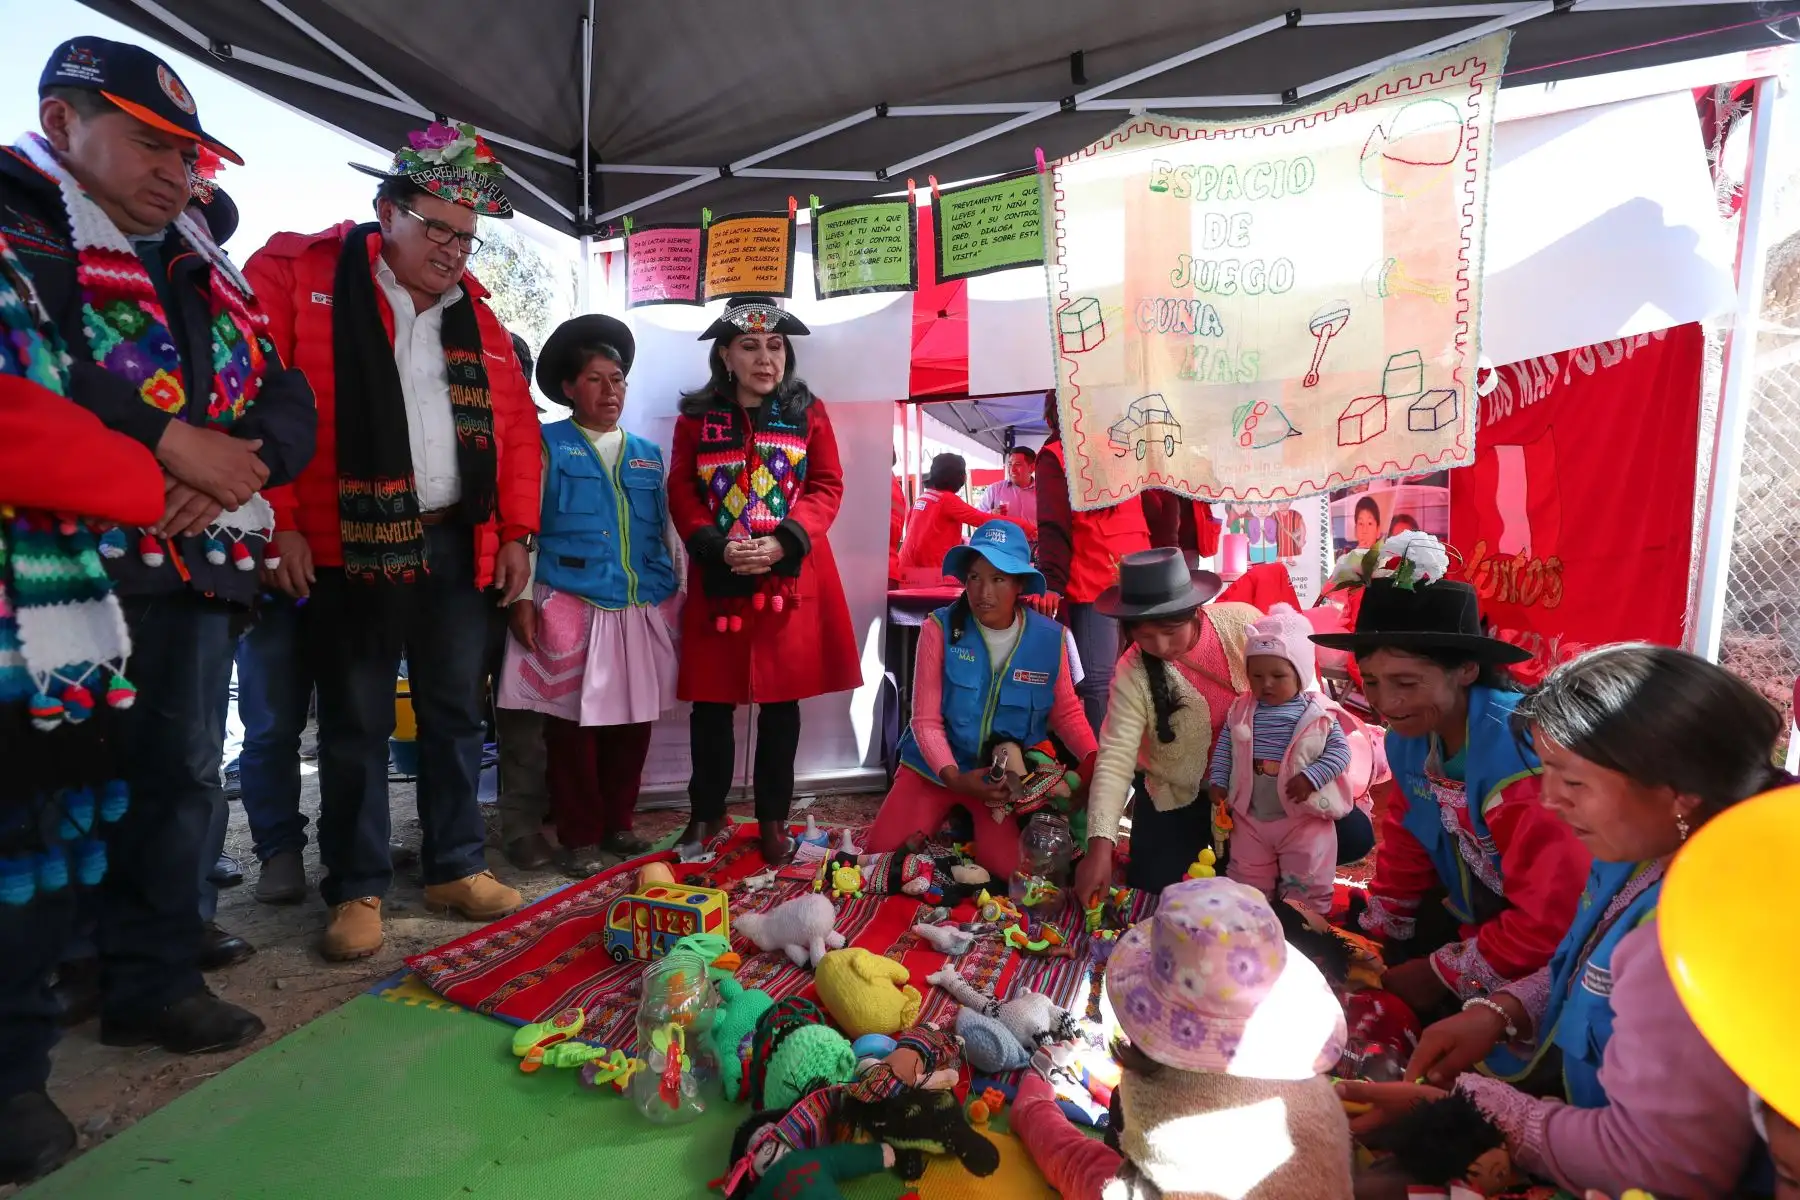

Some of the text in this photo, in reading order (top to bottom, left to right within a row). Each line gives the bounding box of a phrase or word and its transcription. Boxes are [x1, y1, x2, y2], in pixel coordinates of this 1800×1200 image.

[1148, 156, 1315, 201] ESPACIO
[452, 165, 513, 213] HUANCAVELICA
[1022, 187, 1039, 197] QUE
[886, 214, 902, 223] QUE
[951, 210, 976, 221] LLEVES
[951, 221, 972, 231] NIÑO
[988, 216, 999, 224] SU
[1004, 209, 1040, 220] CONTROL
[825, 230, 845, 240] LLEVES
[980, 224, 1013, 235] DIALOGA
[1022, 219, 1040, 228] CON
[1202, 211, 1253, 249] DE
[854, 238, 865, 246] SU
[869, 236, 902, 244] CONTROL
[951, 230, 1039, 251] ELLA O EL SOBRE ESTA
[848, 247, 878, 257] DIALOGA
[883, 256, 902, 264] ESTA
[1170, 253, 1294, 295] JUEGO
[1135, 297, 1224, 337] CUNA
[1177, 344, 1260, 383] MAS
[959, 653, 976, 662] MAS
[653, 909, 694, 936] 1 2 3
